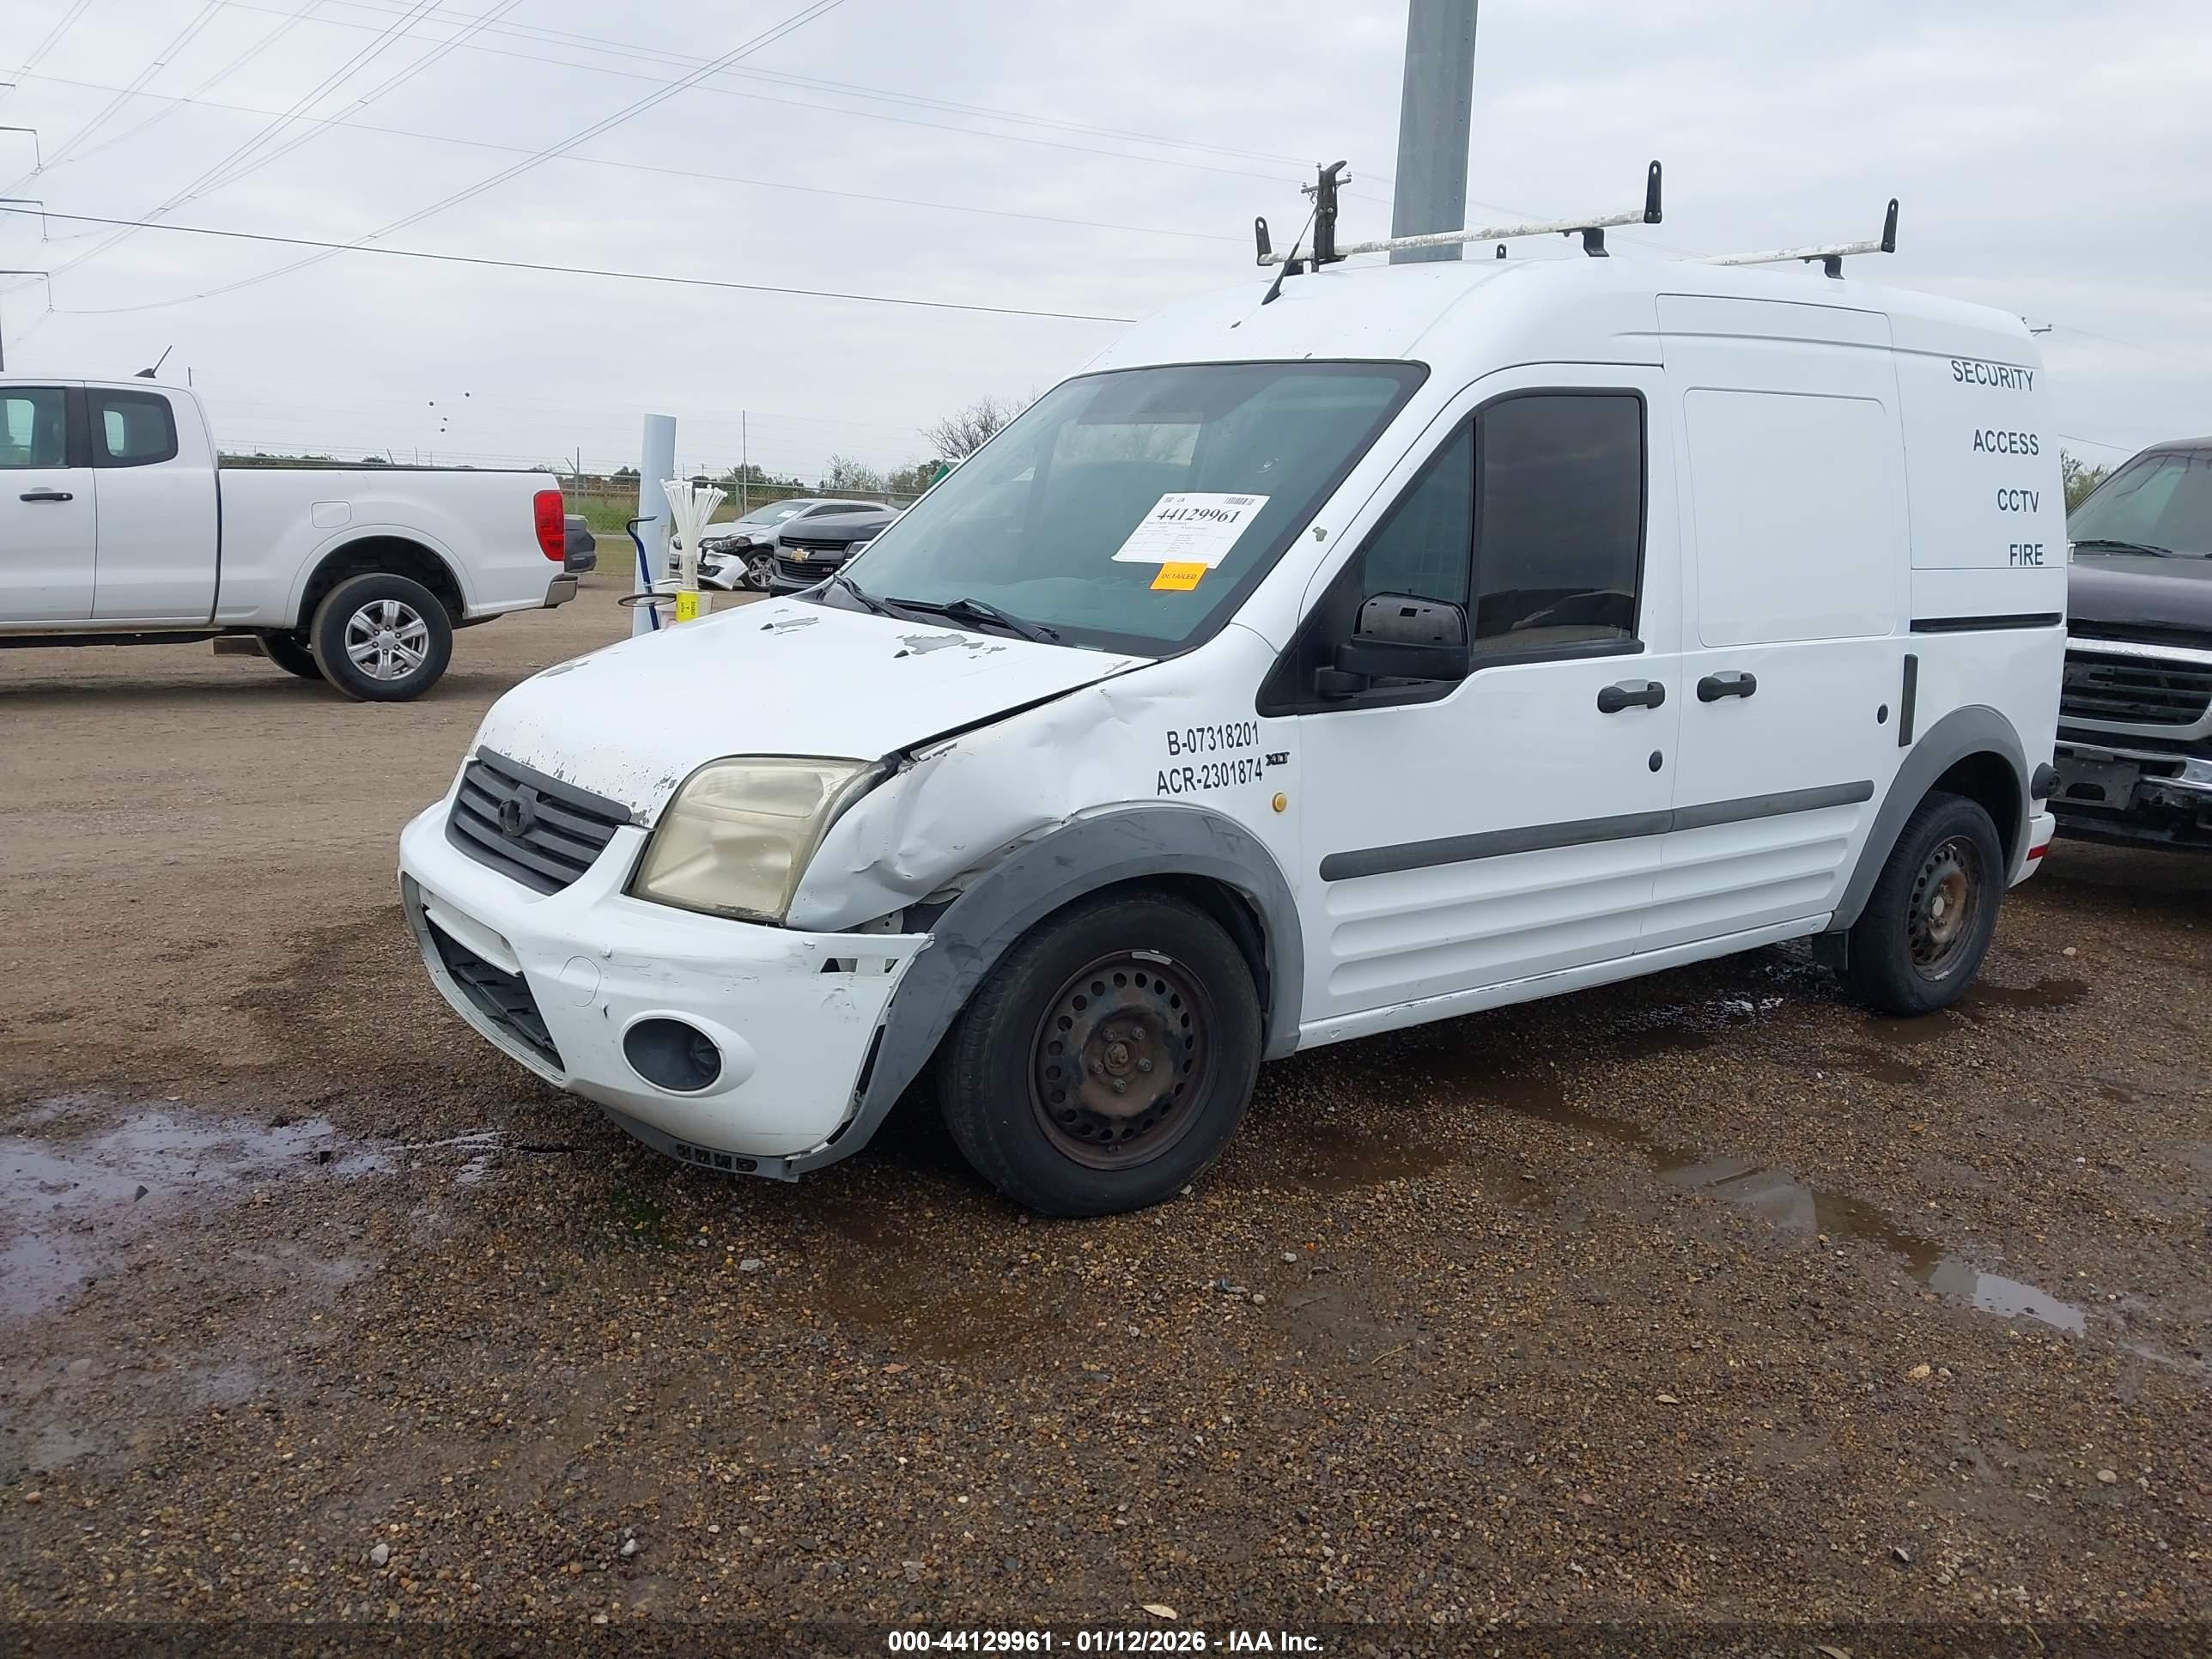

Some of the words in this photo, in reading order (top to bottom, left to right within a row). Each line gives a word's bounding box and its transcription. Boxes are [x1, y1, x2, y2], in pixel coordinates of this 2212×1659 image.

[1951, 360, 2033, 392] SECURITY
[1973, 429, 2039, 456] ACCESS
[1997, 488, 2039, 513] CCTV
[1157, 507, 1243, 524] 44129961
[2009, 544, 2044, 566] FIRE
[1166, 720, 1260, 756] B-07318201
[1157, 757, 1263, 796] ACR-2301874
